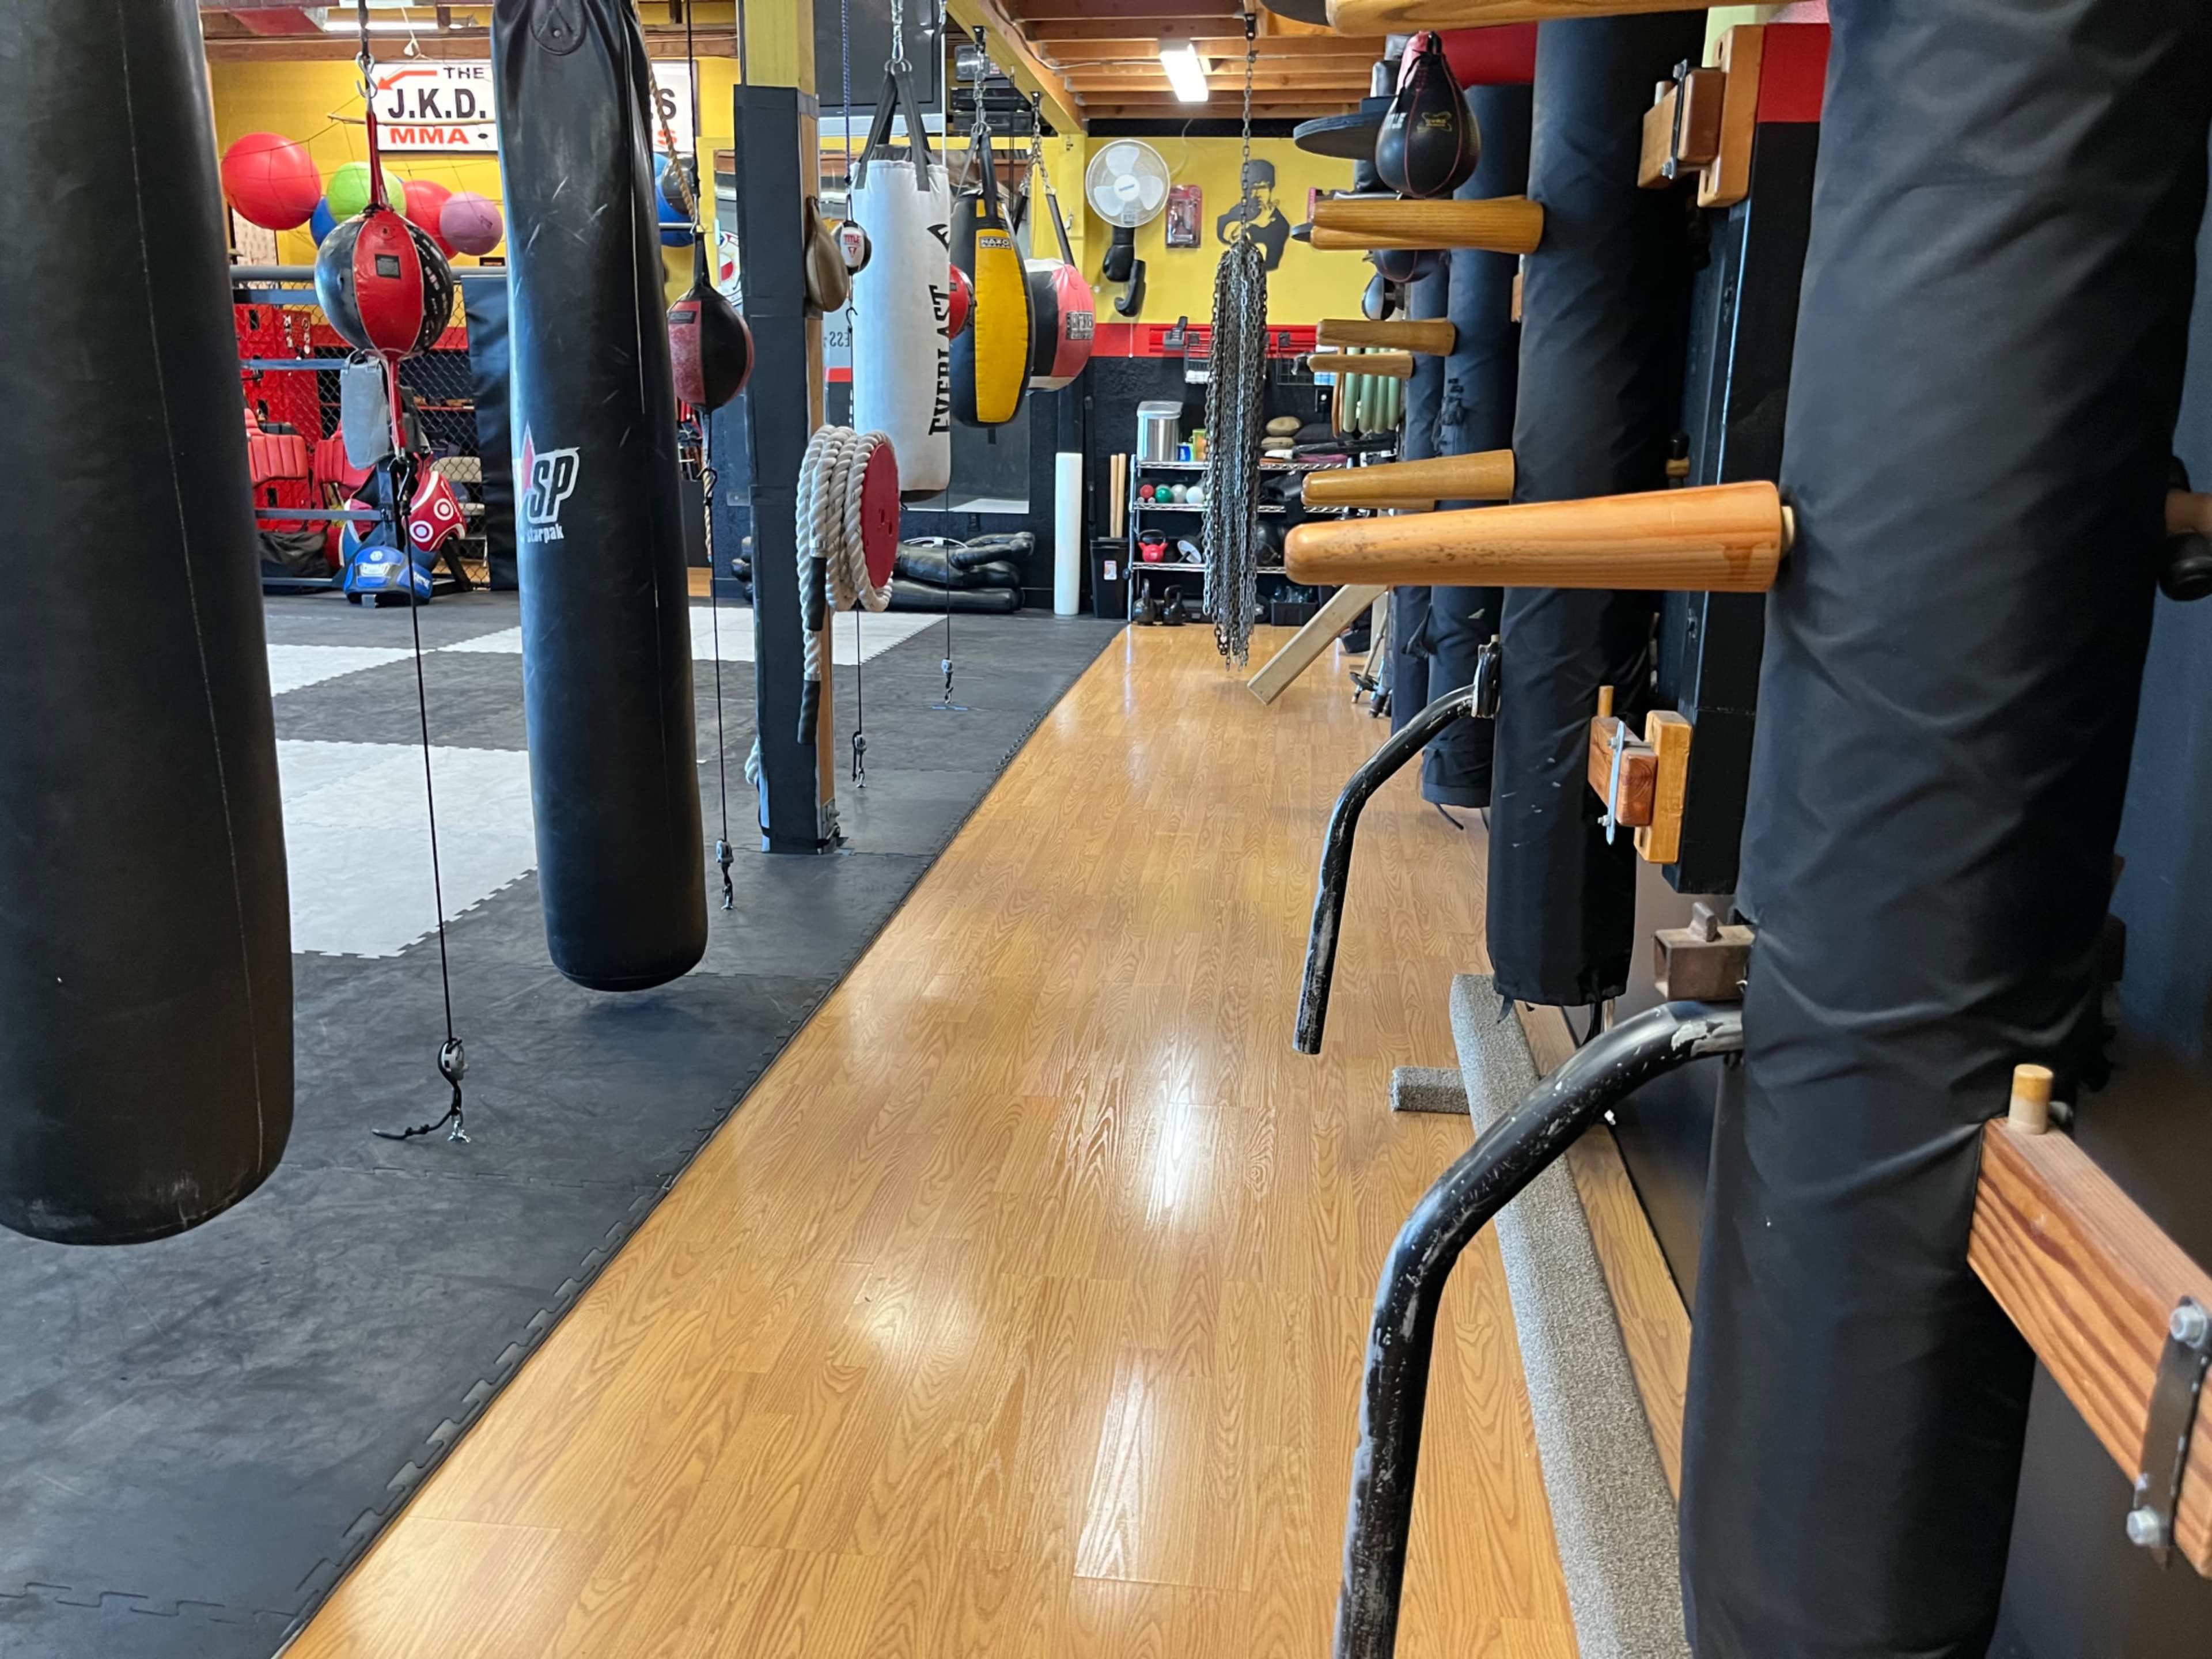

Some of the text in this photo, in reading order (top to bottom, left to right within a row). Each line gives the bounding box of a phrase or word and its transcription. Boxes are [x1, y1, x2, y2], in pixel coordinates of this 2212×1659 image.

[443, 67, 484, 79] THE
[387, 88, 487, 119] J.K.D.
[389, 127, 470, 145] MMA
